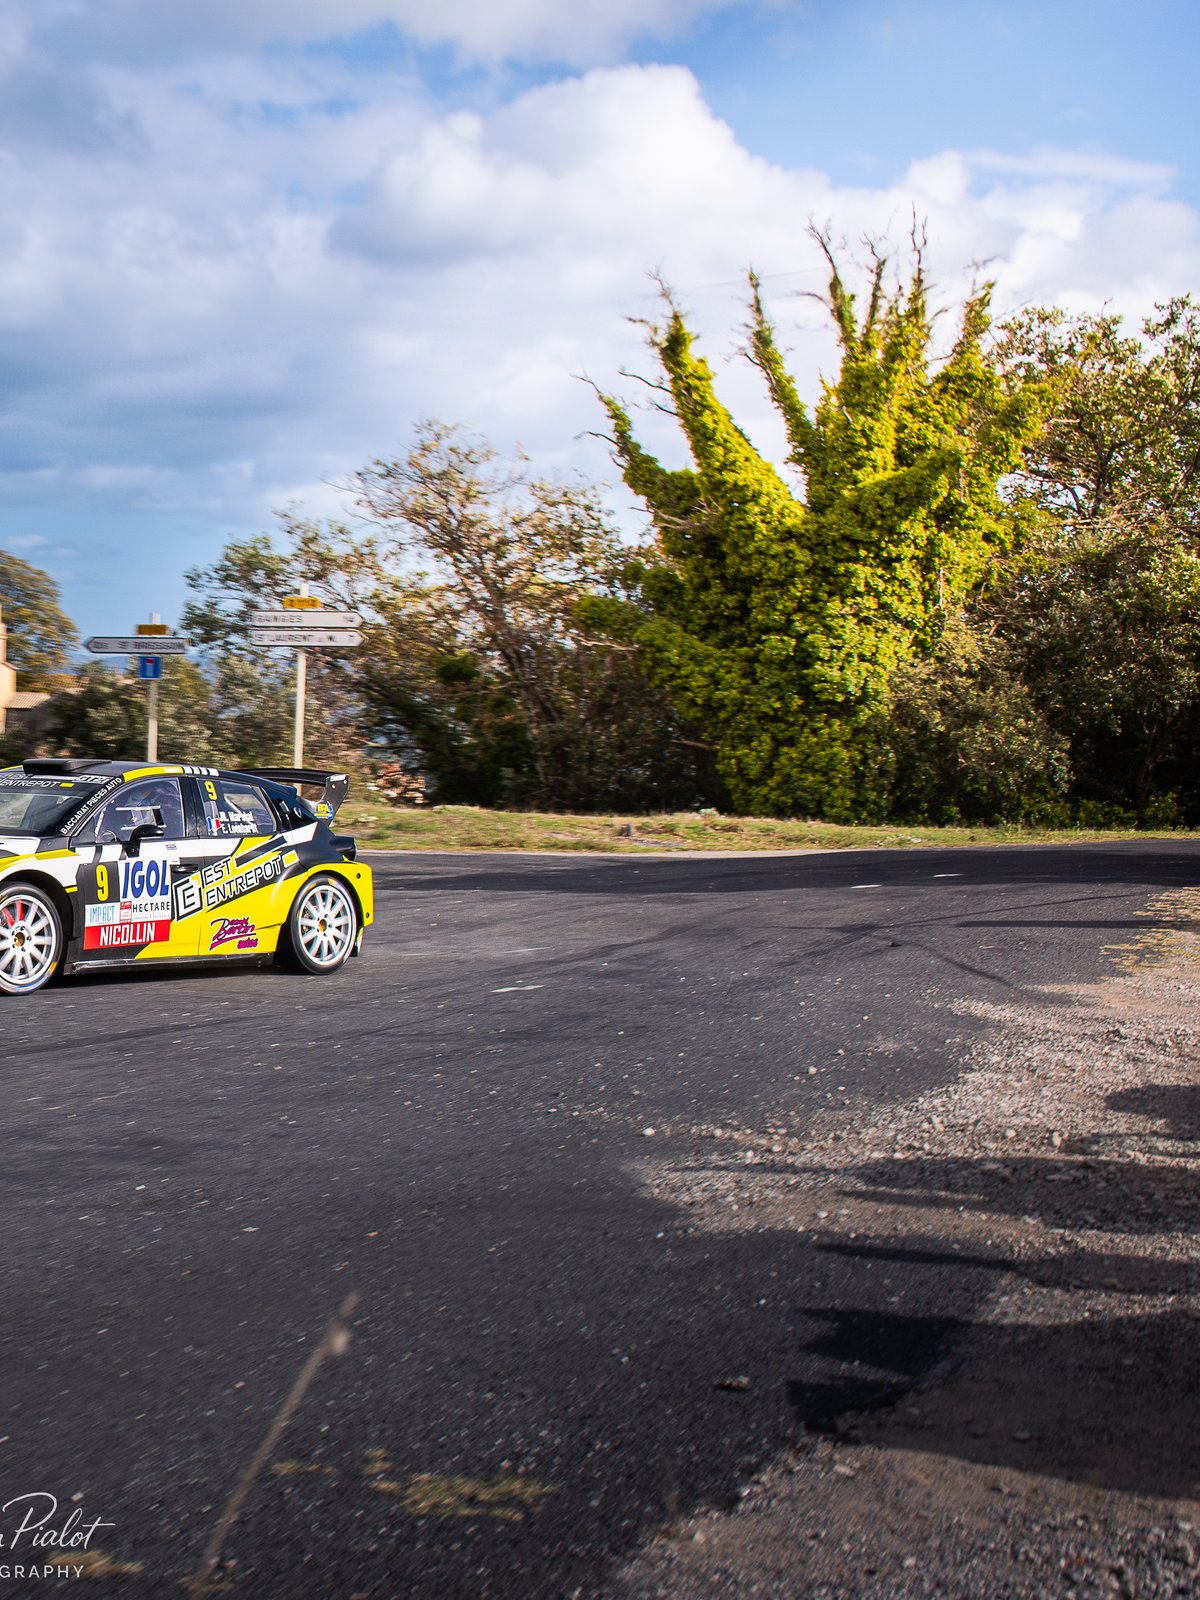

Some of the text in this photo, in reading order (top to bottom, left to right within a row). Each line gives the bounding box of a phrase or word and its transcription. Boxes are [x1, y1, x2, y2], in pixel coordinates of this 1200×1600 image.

[0, 780, 61, 788] ENTREPOT
[204, 780, 218, 801] 9
[60, 777, 123, 835] BACCARAT PIECES AUTO
[95, 864, 109, 902] 9
[122, 860, 170, 899] IGOL
[203, 858, 232, 886] EST
[206, 856, 281, 907] ENTREPOT
[89, 905, 115, 923] IMPACT
[132, 902, 170, 913] HECTARE
[100, 922, 156, 947] NICOLLIN
